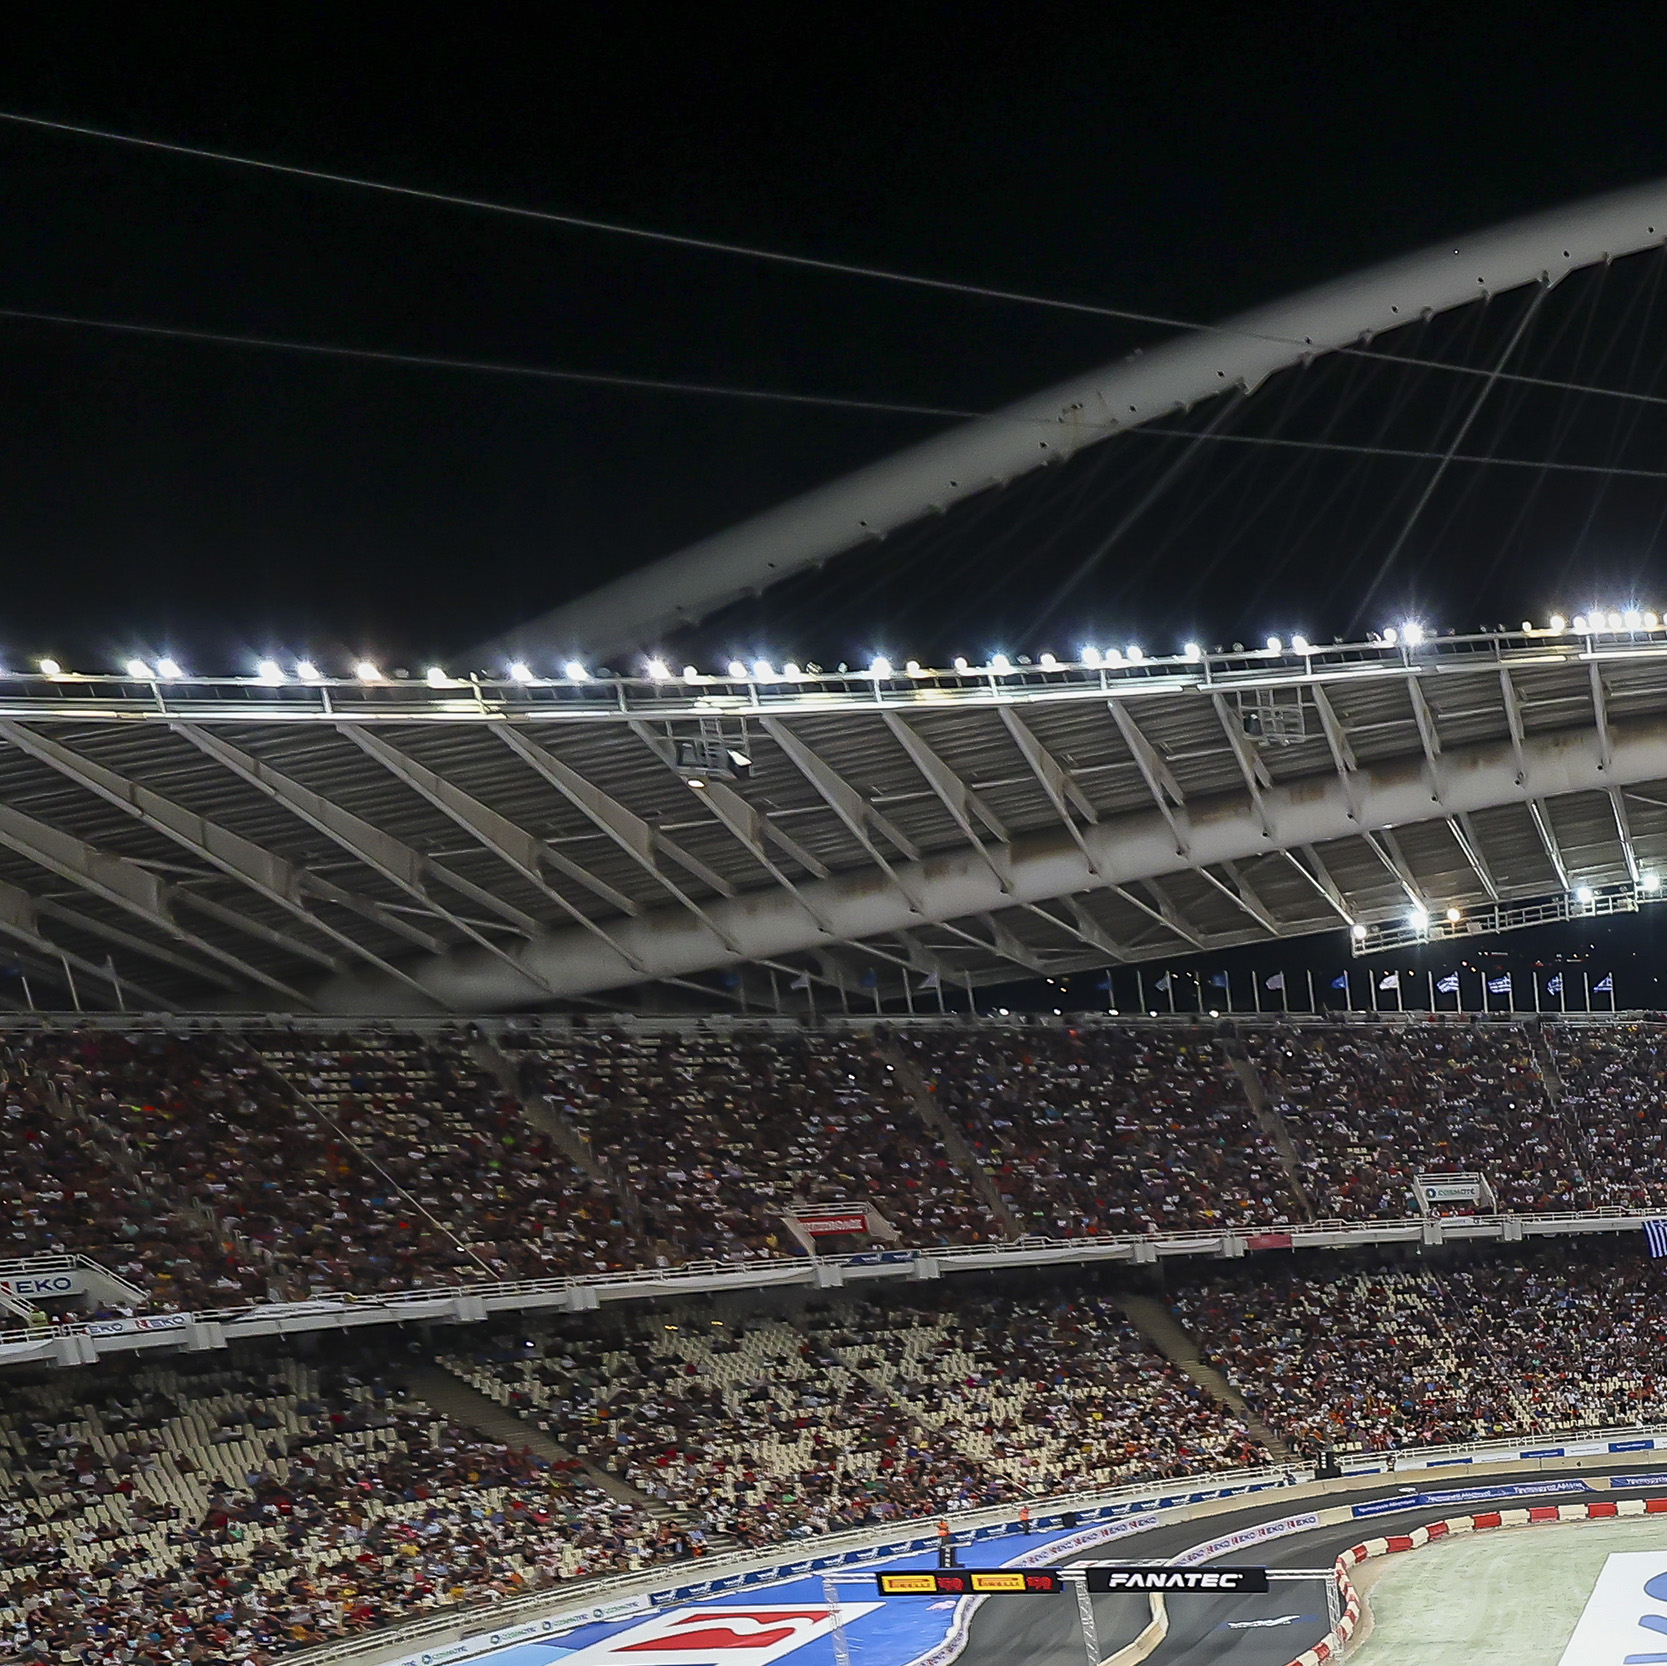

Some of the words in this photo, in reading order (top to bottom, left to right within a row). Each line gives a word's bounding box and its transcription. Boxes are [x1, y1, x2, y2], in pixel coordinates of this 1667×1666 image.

[16, 1277, 71, 1294] EKO
[1296, 1516, 1316, 1526] EKO
[1109, 1573, 1242, 1588] FANATEC
